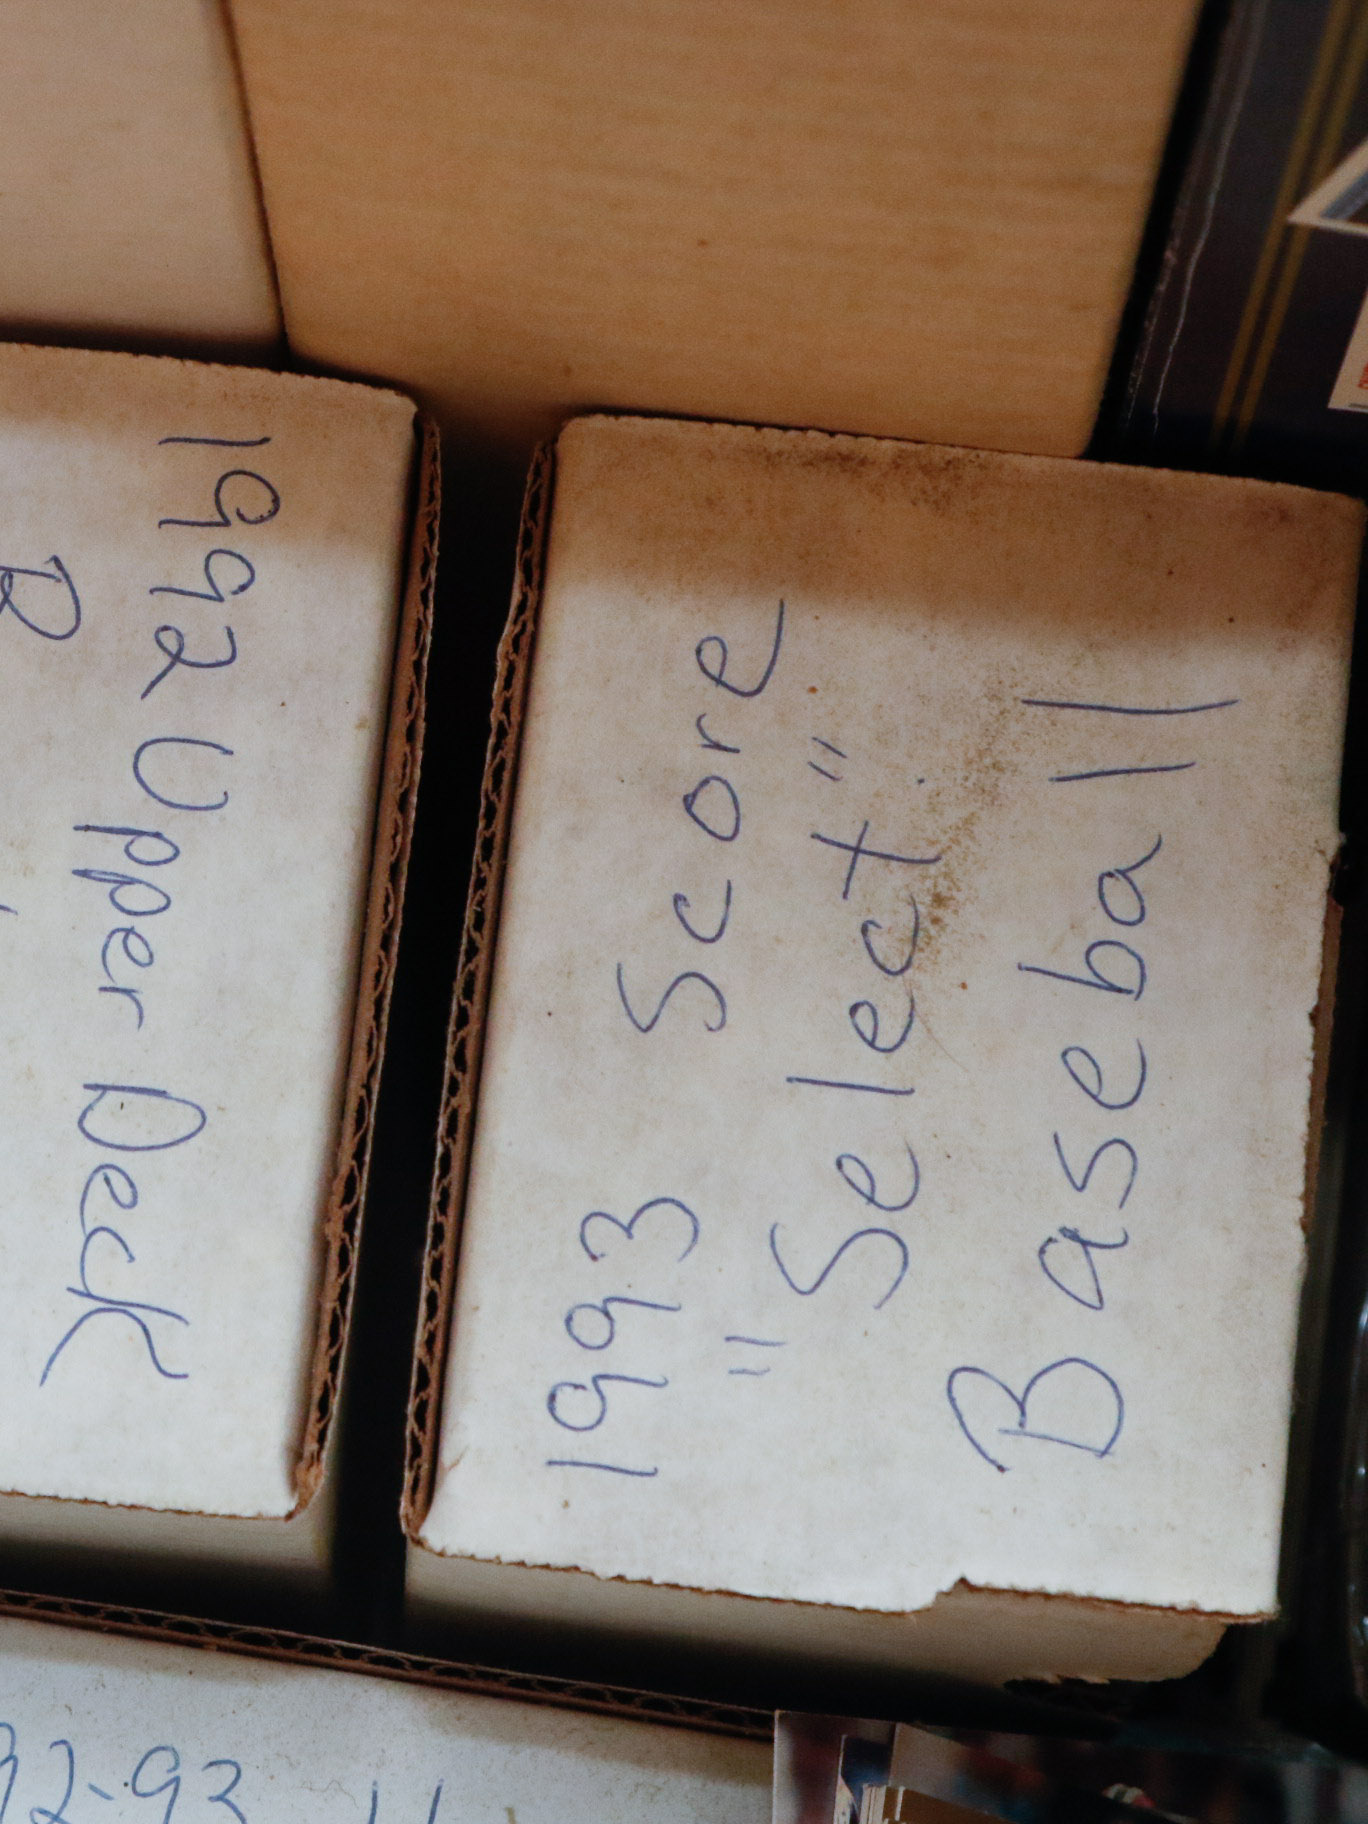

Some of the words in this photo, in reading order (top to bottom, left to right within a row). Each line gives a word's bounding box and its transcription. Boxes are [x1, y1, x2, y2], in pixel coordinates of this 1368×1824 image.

[141, 437, 280, 700] 1992
[72, 737, 234, 1030] Upper
[617, 599, 784, 1034] Score
[947, 699, 1238, 1474] Baseball
[545, 1197, 699, 1477] 1993
